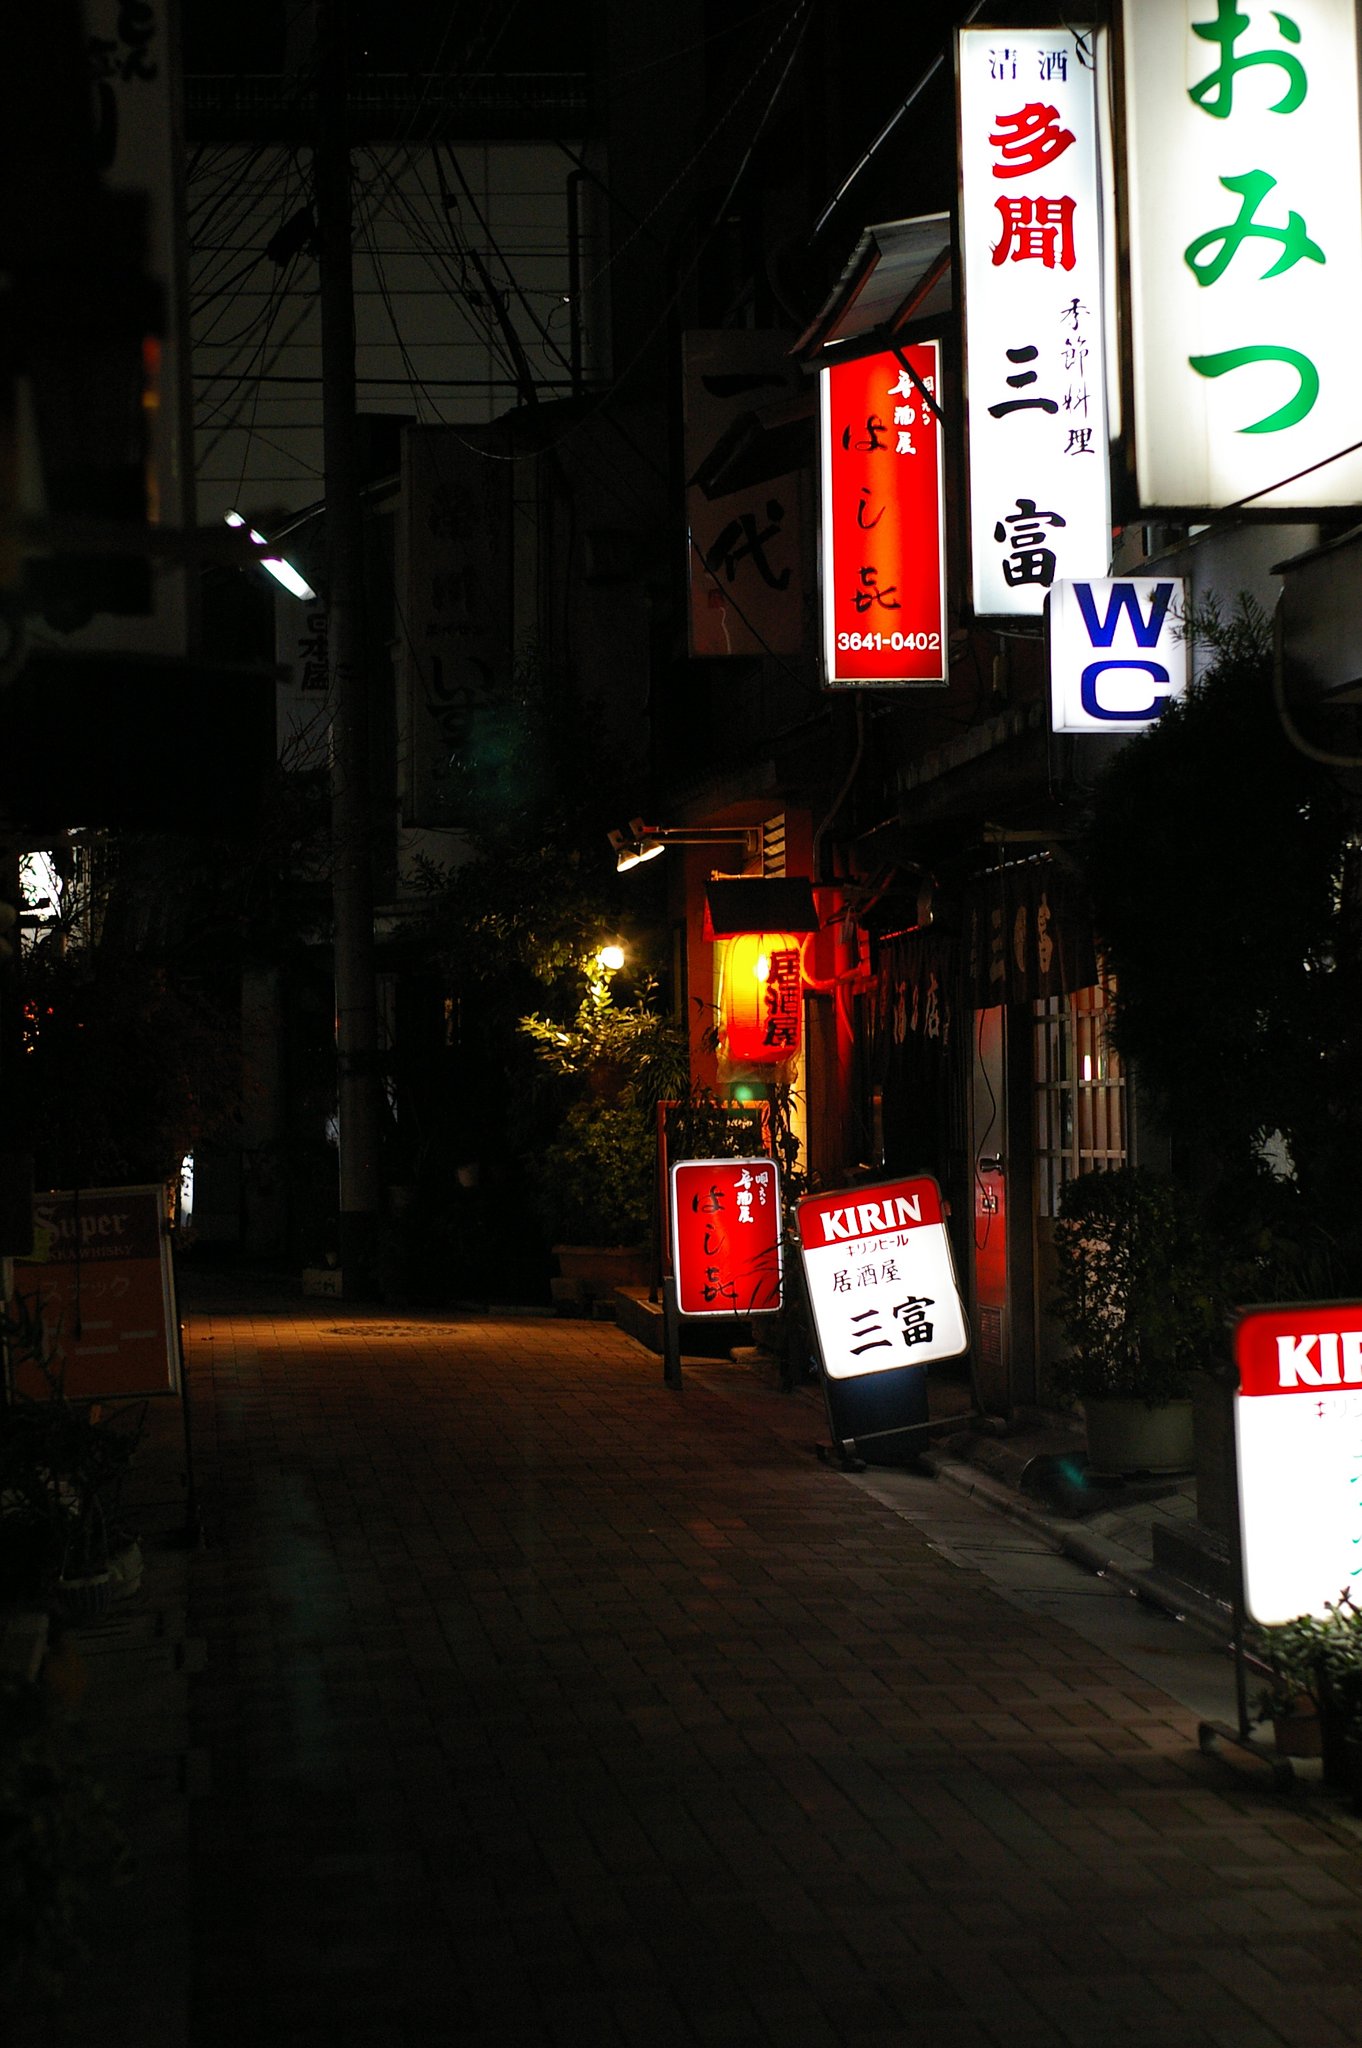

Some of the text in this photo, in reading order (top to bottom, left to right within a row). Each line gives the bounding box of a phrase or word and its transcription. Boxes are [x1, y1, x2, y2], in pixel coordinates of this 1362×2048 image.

[988, 49, 1069, 82] 清酒
[988, 102, 1077, 271] 多聞
[1184, 0, 1327, 433] おみつ
[1061, 298, 1095, 455] 季節料理
[988, 346, 1067, 587] 三富
[837, 631, 941, 652] 3641-0402
[820, 1194, 922, 1242] KIRIN
[833, 1259, 902, 1293] 居酒屋
[850, 1296, 935, 1356] 三富
